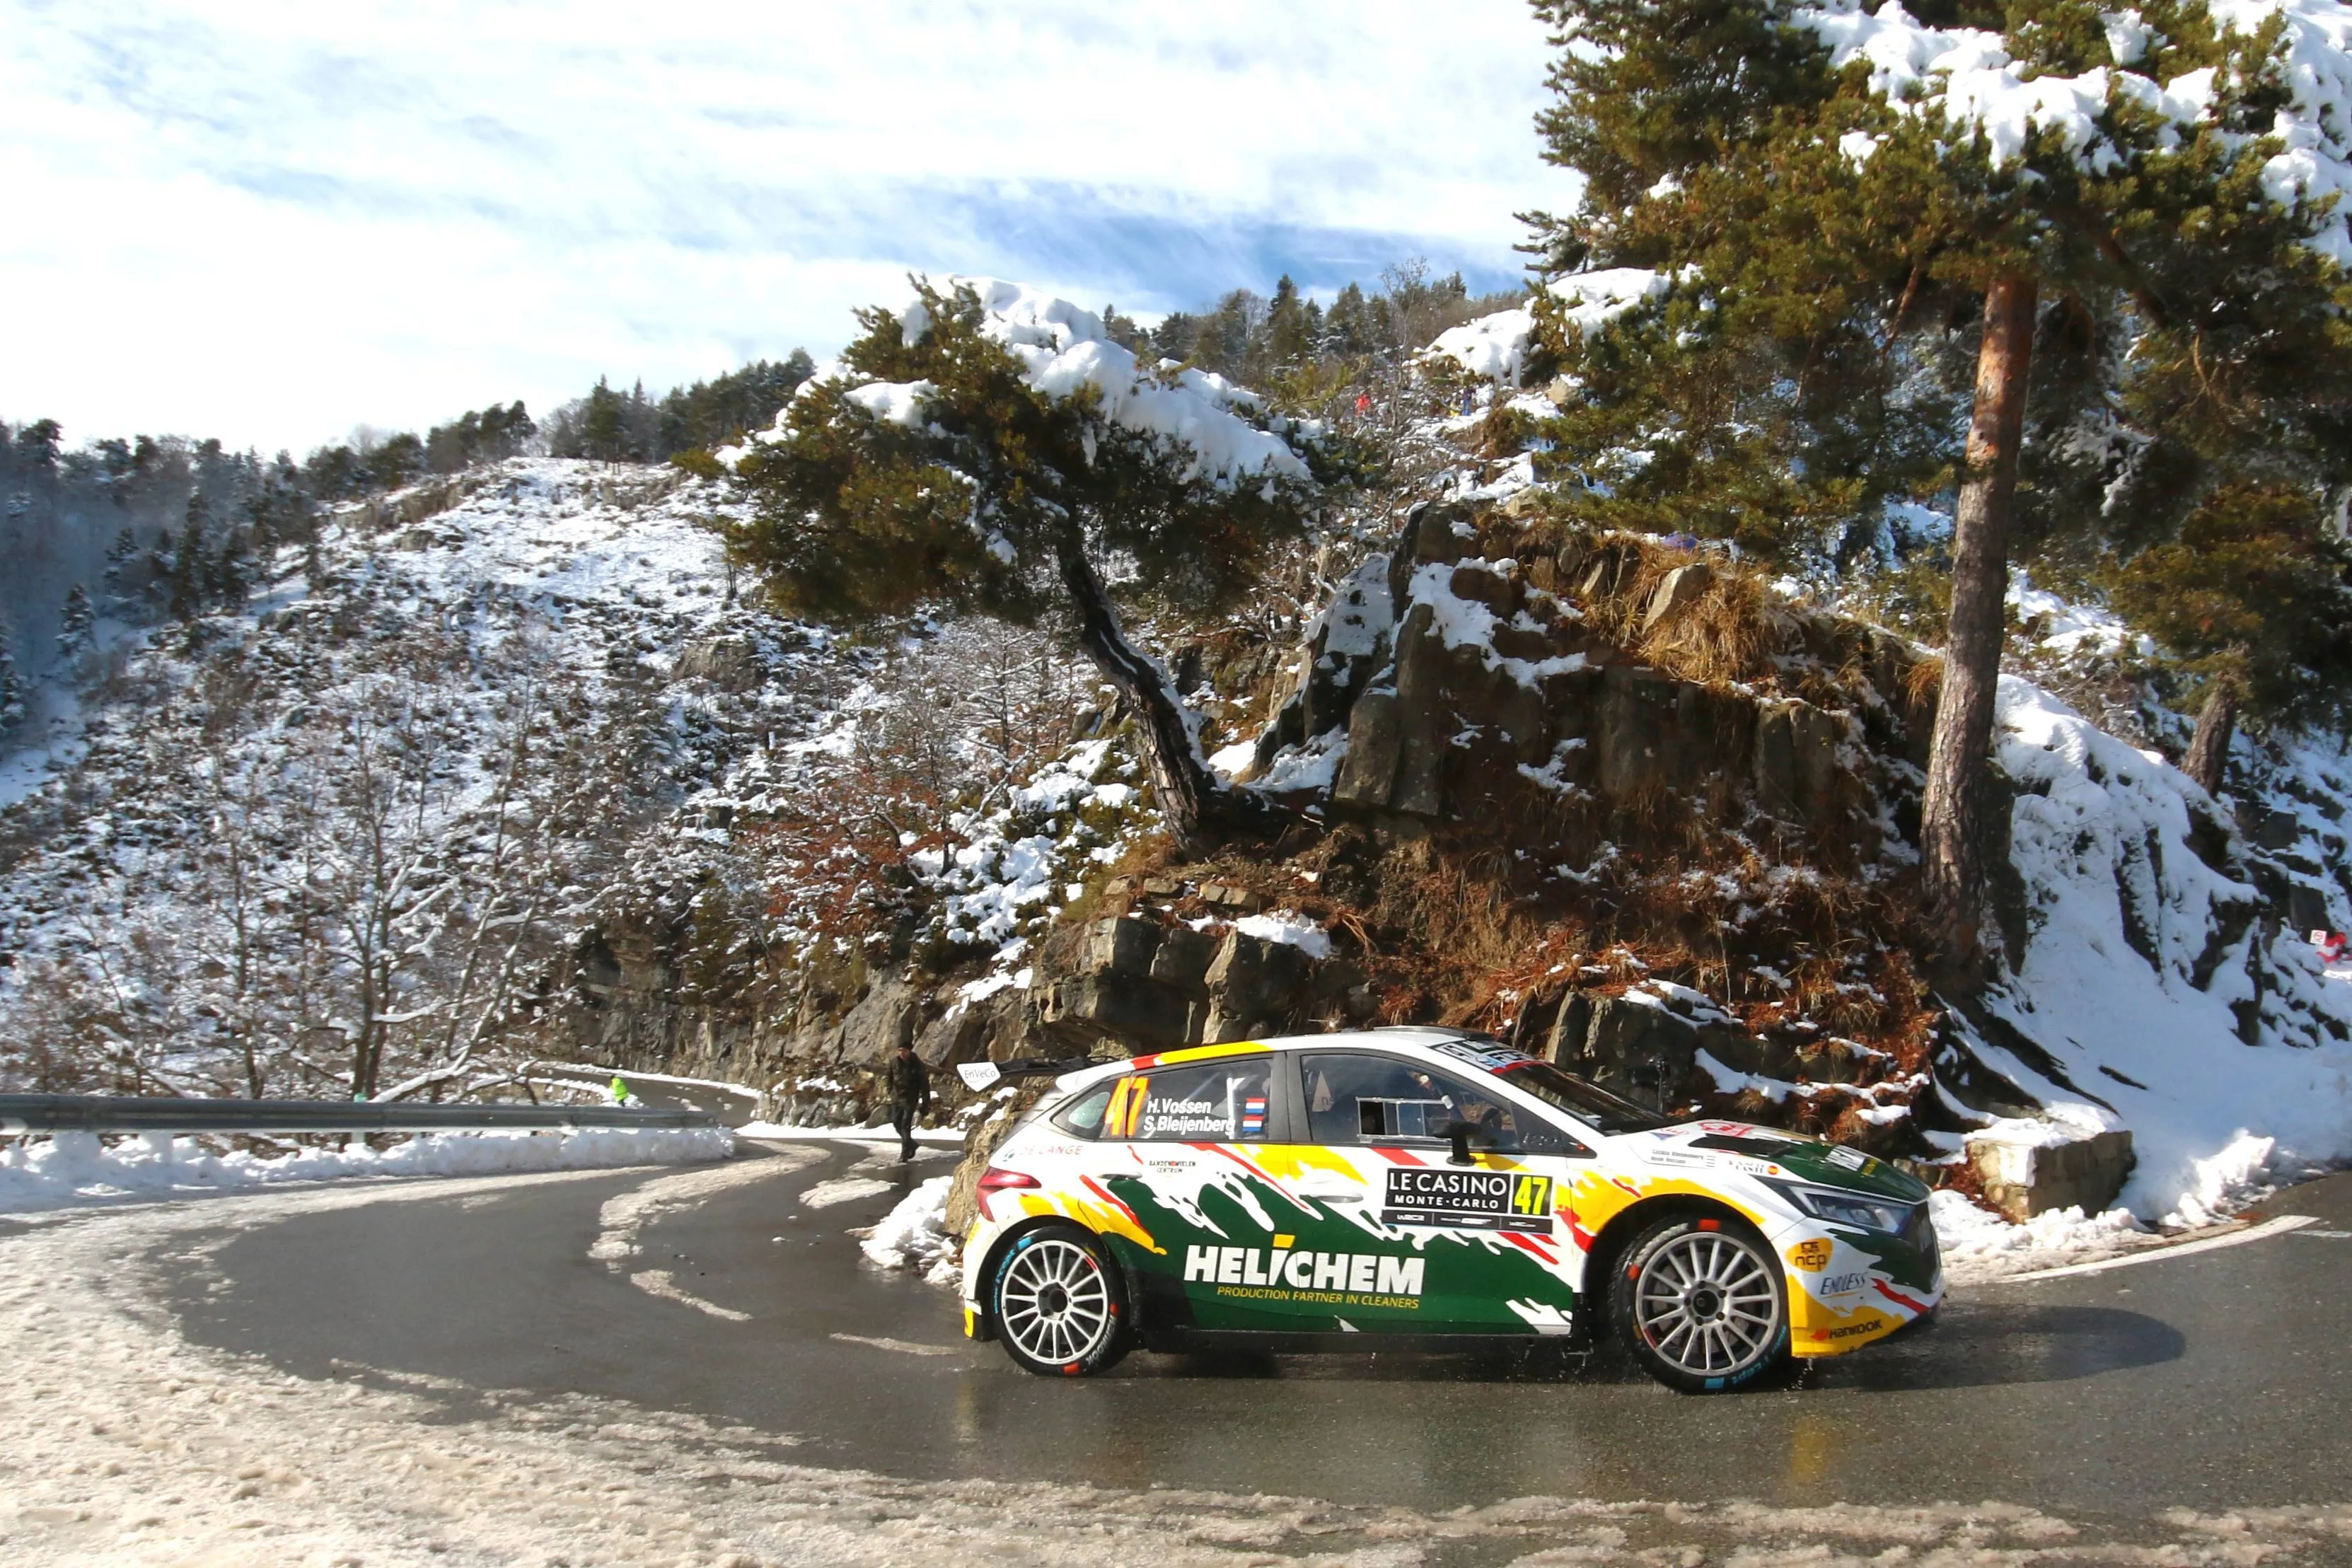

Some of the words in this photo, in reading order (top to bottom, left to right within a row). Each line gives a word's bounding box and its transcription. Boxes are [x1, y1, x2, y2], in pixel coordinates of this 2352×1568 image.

[964, 1069, 996, 1079] EnVeCo
[1105, 1076, 1150, 1136] 47
[1389, 1172, 1412, 1191] LE
[1416, 1173, 1507, 1196] CASINO
[1514, 1176, 1548, 1215] 47
[1183, 1233, 1425, 1295] HELICHEM
[1217, 1286, 1289, 1300] PRODUCTION
[1292, 1291, 1343, 1303] PARTNER
[1346, 1294, 1357, 1304] IN
[1361, 1295, 1420, 1308] CLEANERS
